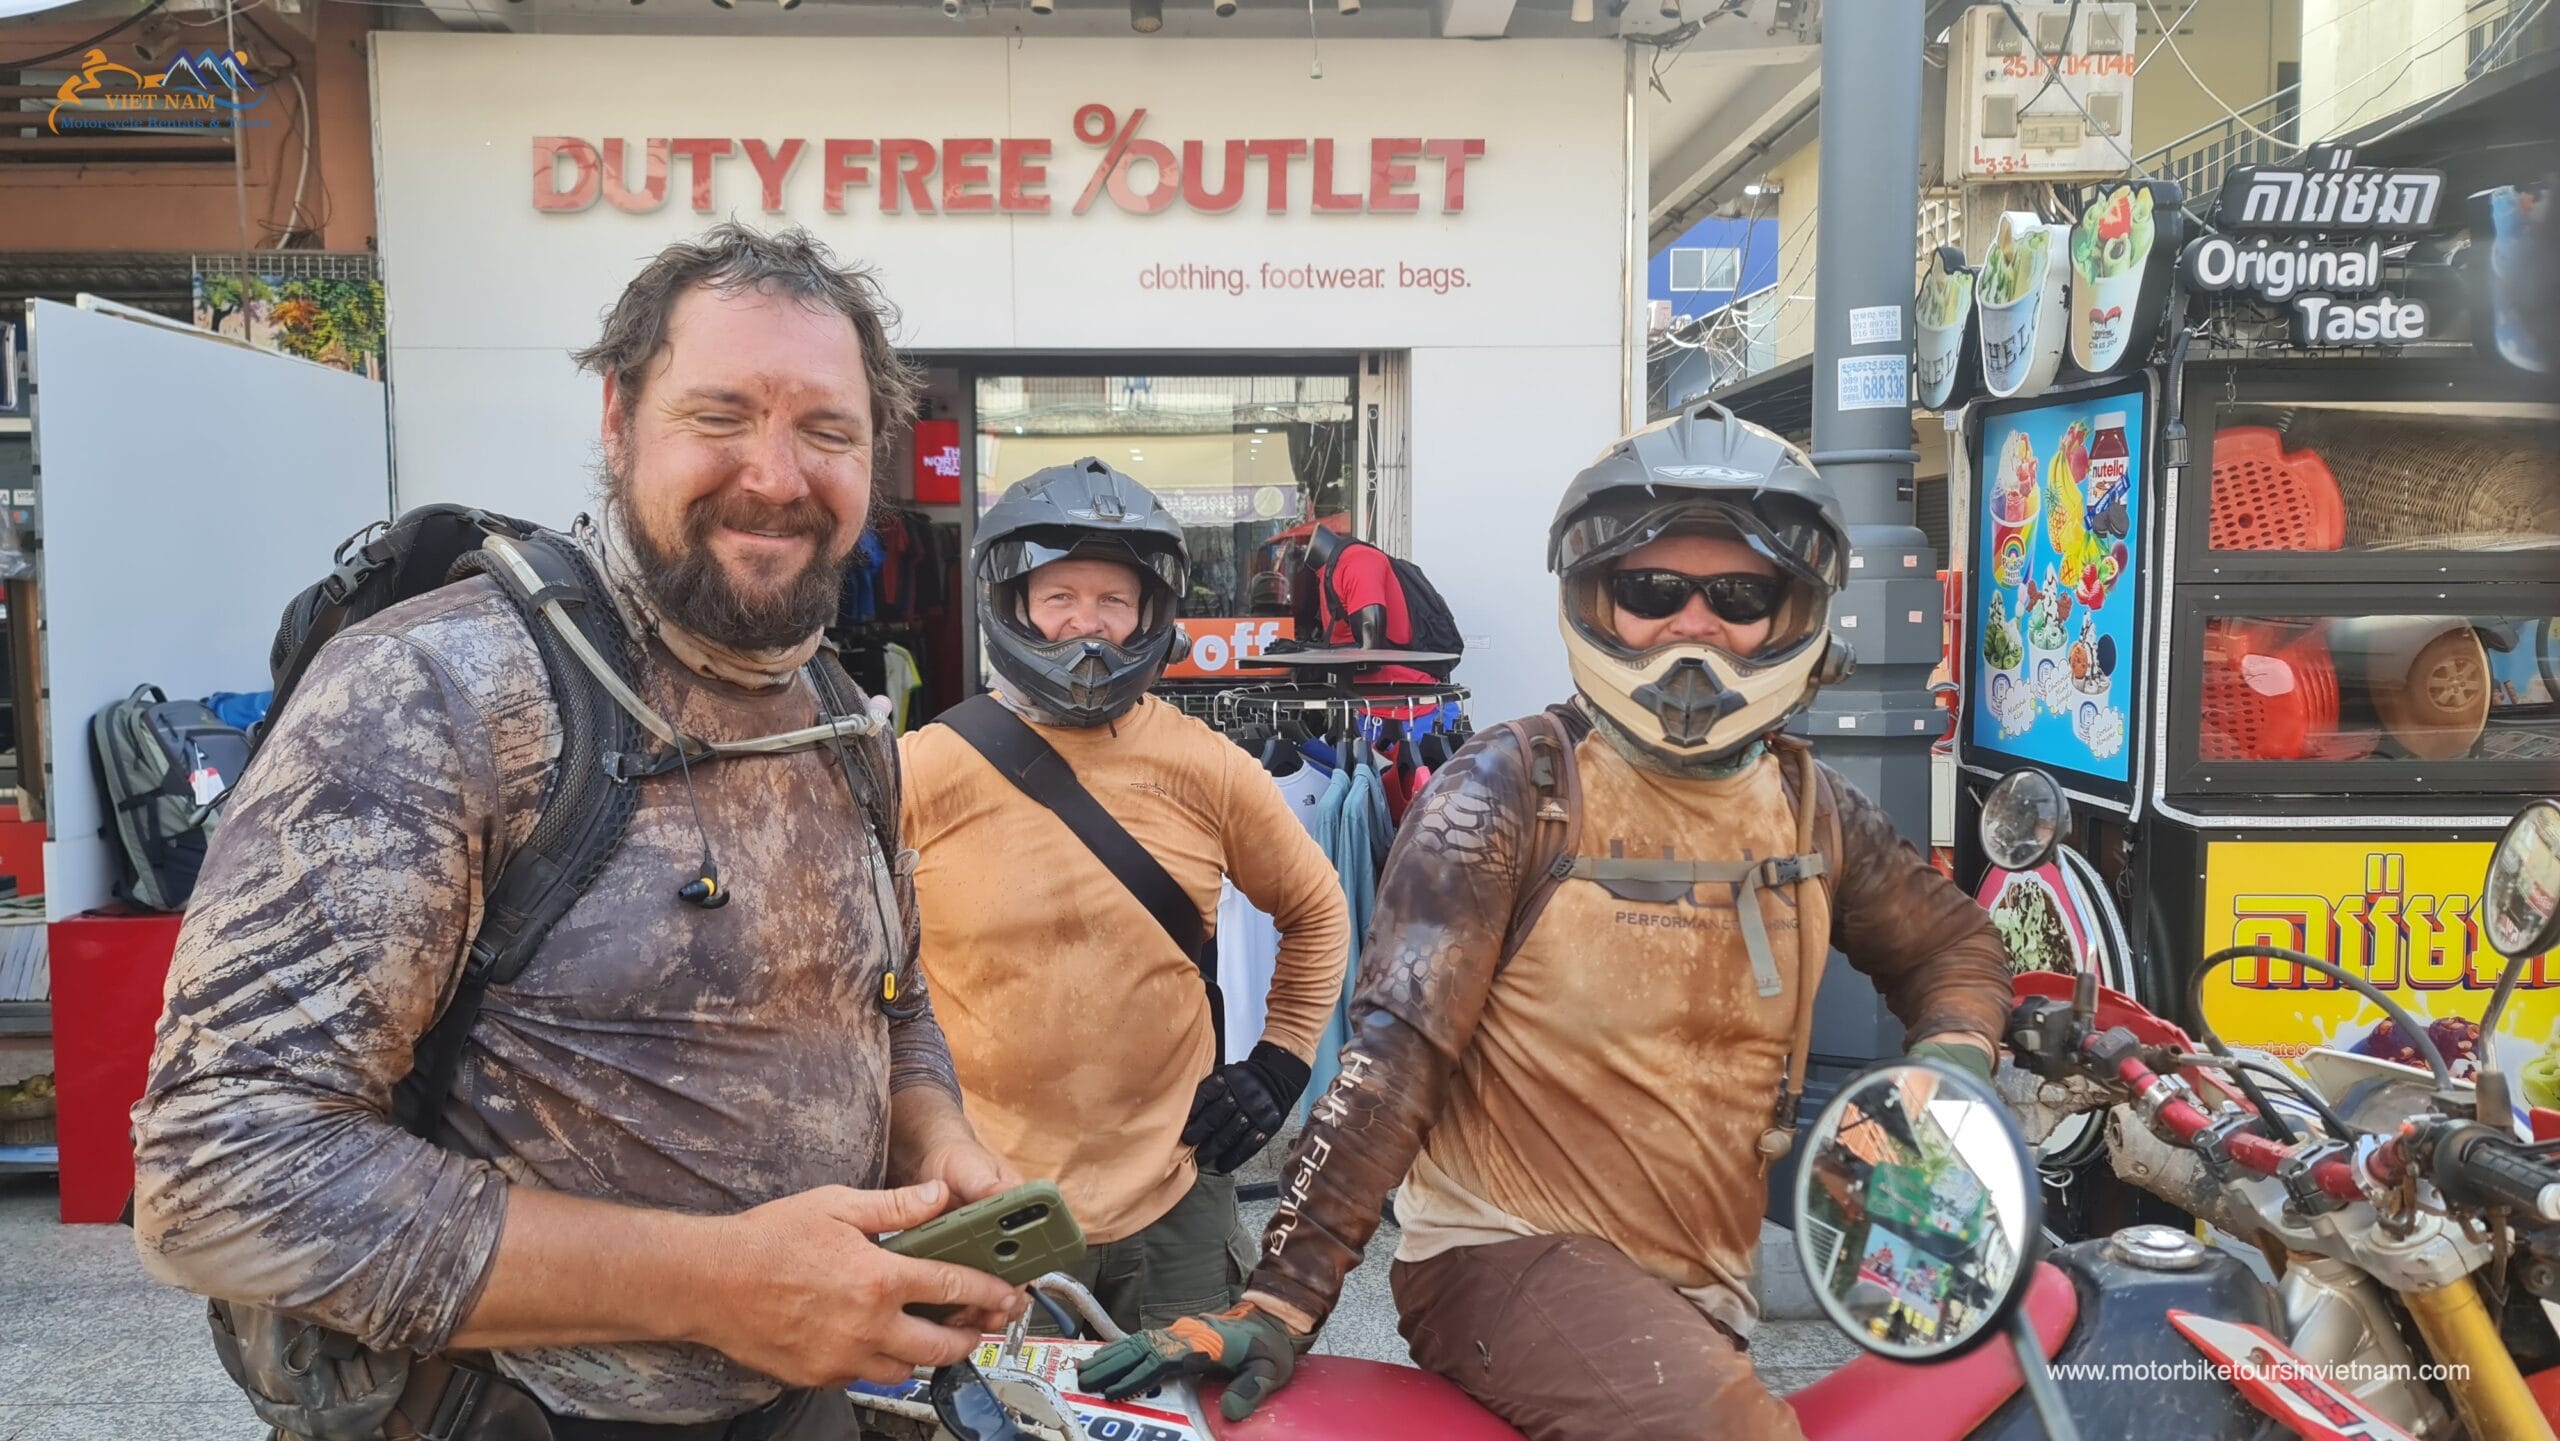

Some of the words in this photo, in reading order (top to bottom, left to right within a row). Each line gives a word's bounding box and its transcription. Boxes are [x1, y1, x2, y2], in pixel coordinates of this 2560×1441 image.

[533, 136, 806, 213] DUTY
[824, 138, 1051, 214] FREE
[1139, 263, 1250, 296] clothing.
[1400, 261, 1471, 295] bags.
[2198, 239, 2378, 296] Original
[2300, 297, 2424, 340] Taste
[2093, 459, 2124, 478] nutella
[1193, 621, 1280, 671] off
